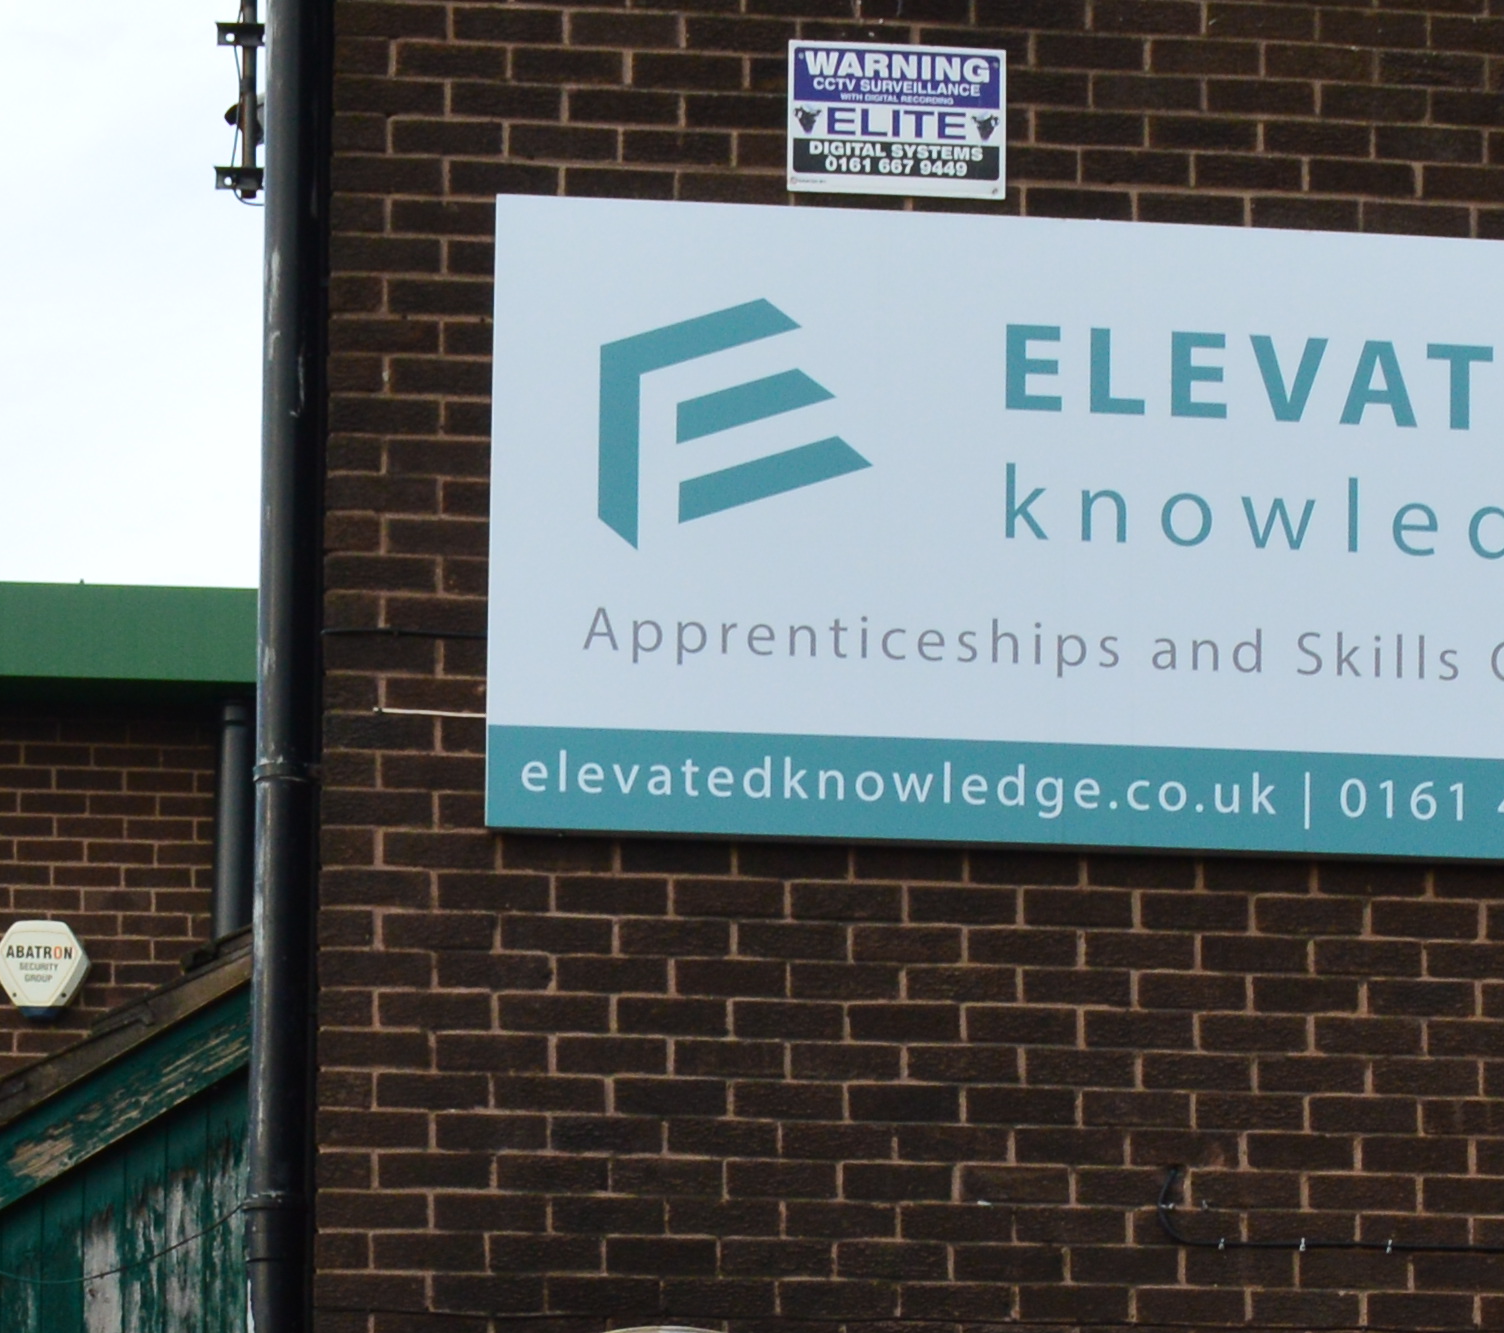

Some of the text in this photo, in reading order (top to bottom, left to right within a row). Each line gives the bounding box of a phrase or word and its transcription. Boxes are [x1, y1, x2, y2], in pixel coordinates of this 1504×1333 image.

[805, 50, 990, 83] WARNING
[812, 77, 981, 97] CCTV SURVEILLANCE
[840, 92, 954, 106] WITH DIGITAL RECORDING
[827, 106, 967, 141] ELITE
[809, 140, 984, 162] DIGITAL SYSTEMS
[824, 155, 968, 177] 0161 667 9449
[582, 606, 1120, 679] Apprenticeships
[1151, 627, 1262, 674] and
[1296, 631, 1459, 681] Skills
[521, 749, 1276, 819] elevatedknowledge.co.uk
[1339, 777, 1464, 822] 0161
[5, 945, 73, 960] ABATRON
[19, 962, 59, 971] SECURITY
[24, 974, 53, 983] GROUP
